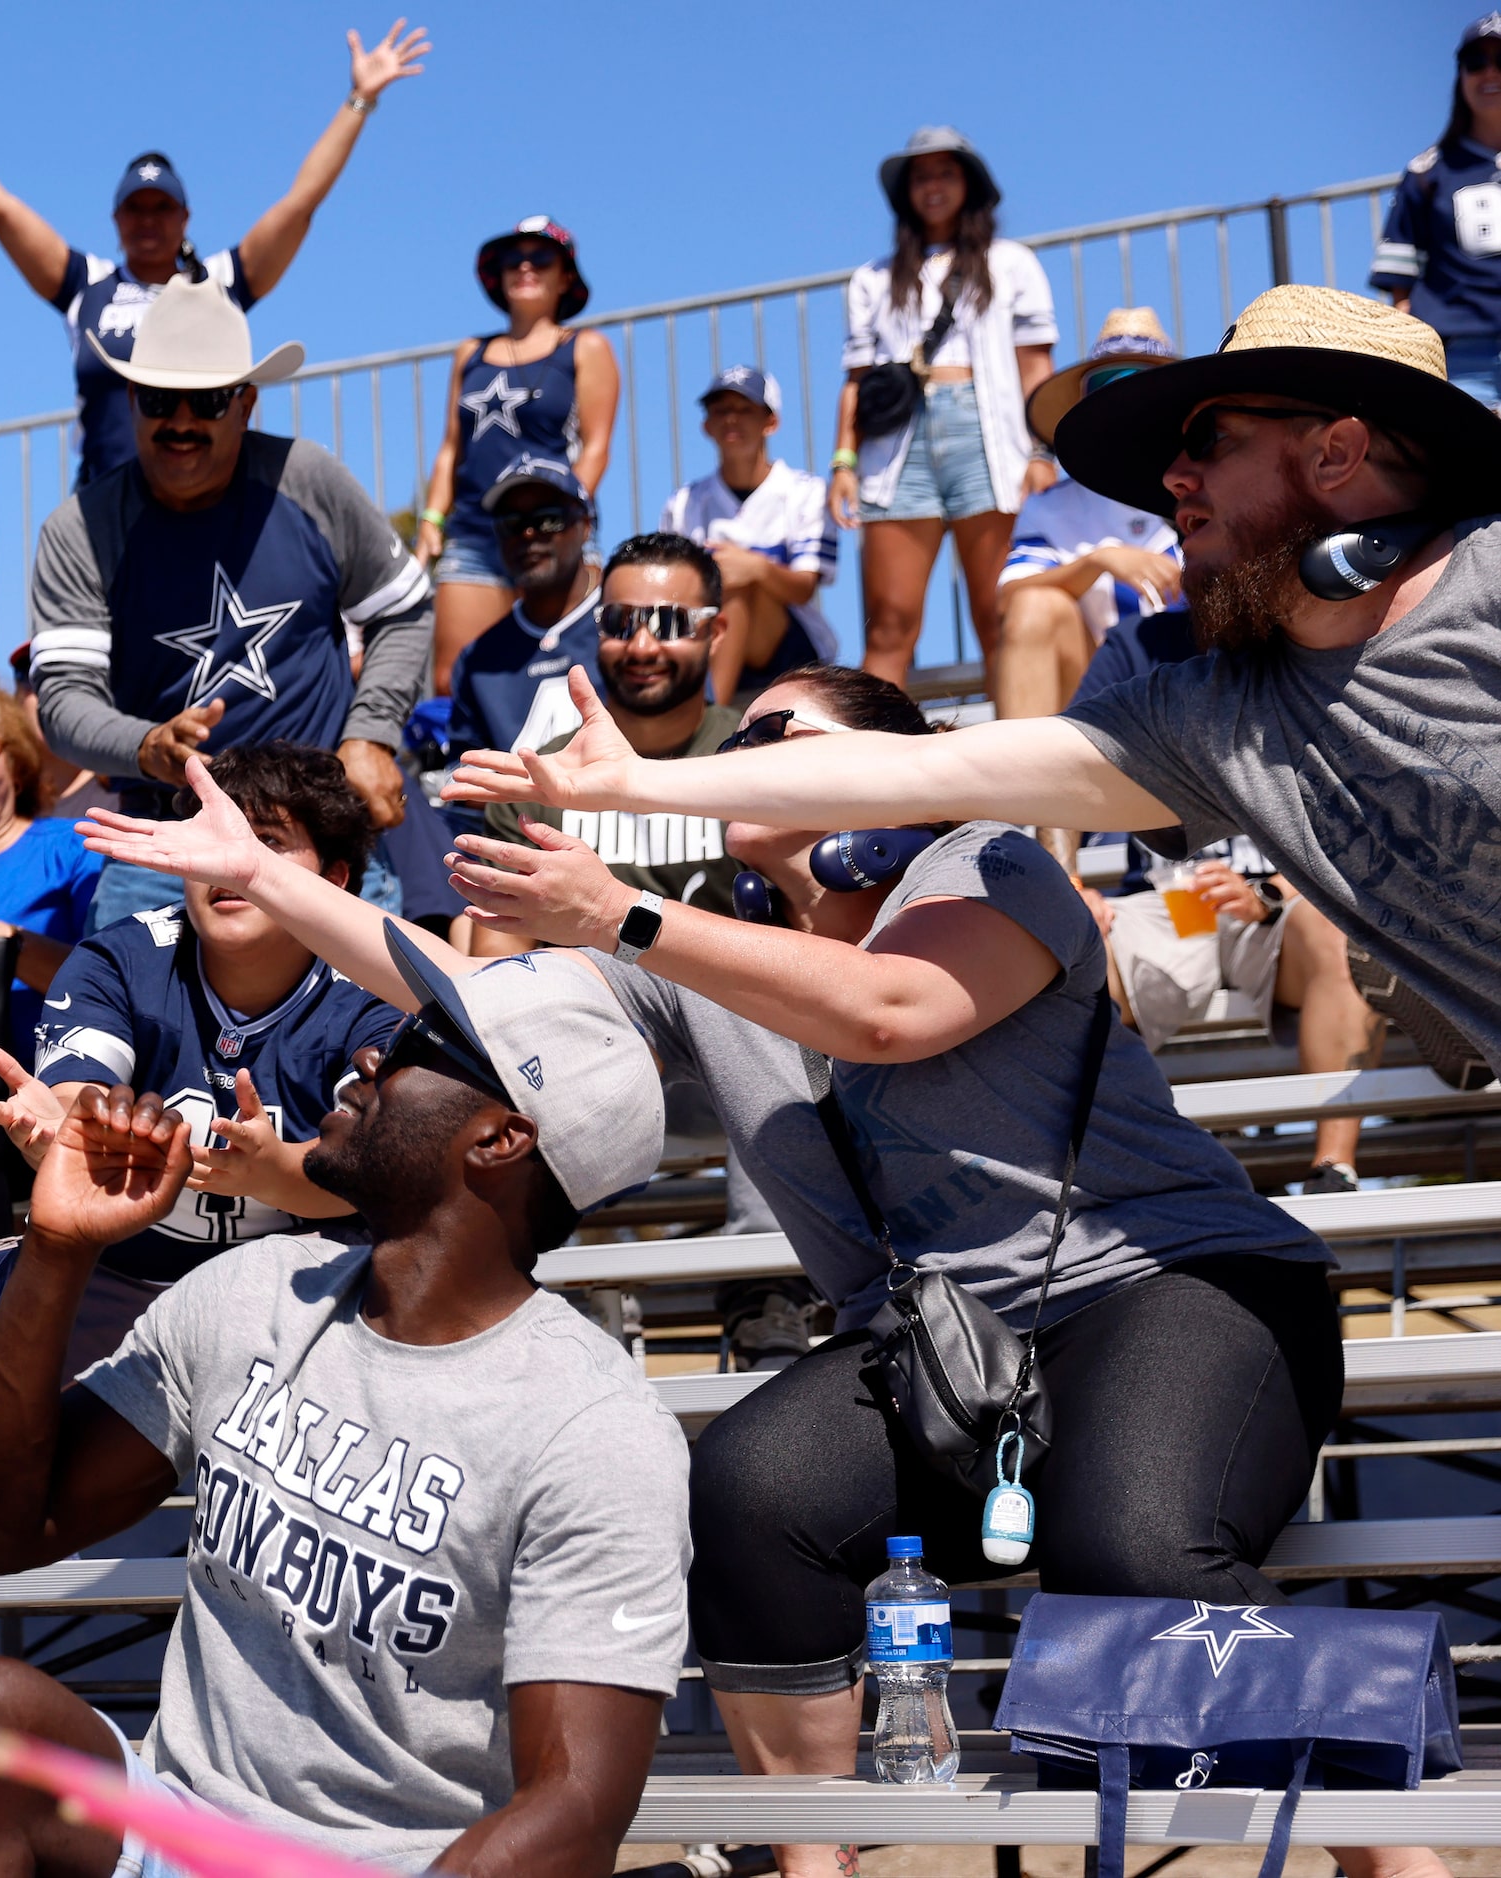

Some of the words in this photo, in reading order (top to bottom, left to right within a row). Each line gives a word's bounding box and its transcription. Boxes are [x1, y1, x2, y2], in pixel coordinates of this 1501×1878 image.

[561, 808, 725, 868] PUMA
[218, 1036, 241, 1055] NFL
[211, 1356, 466, 1557] DALLAS
[195, 1448, 461, 1658] COWBOYS
